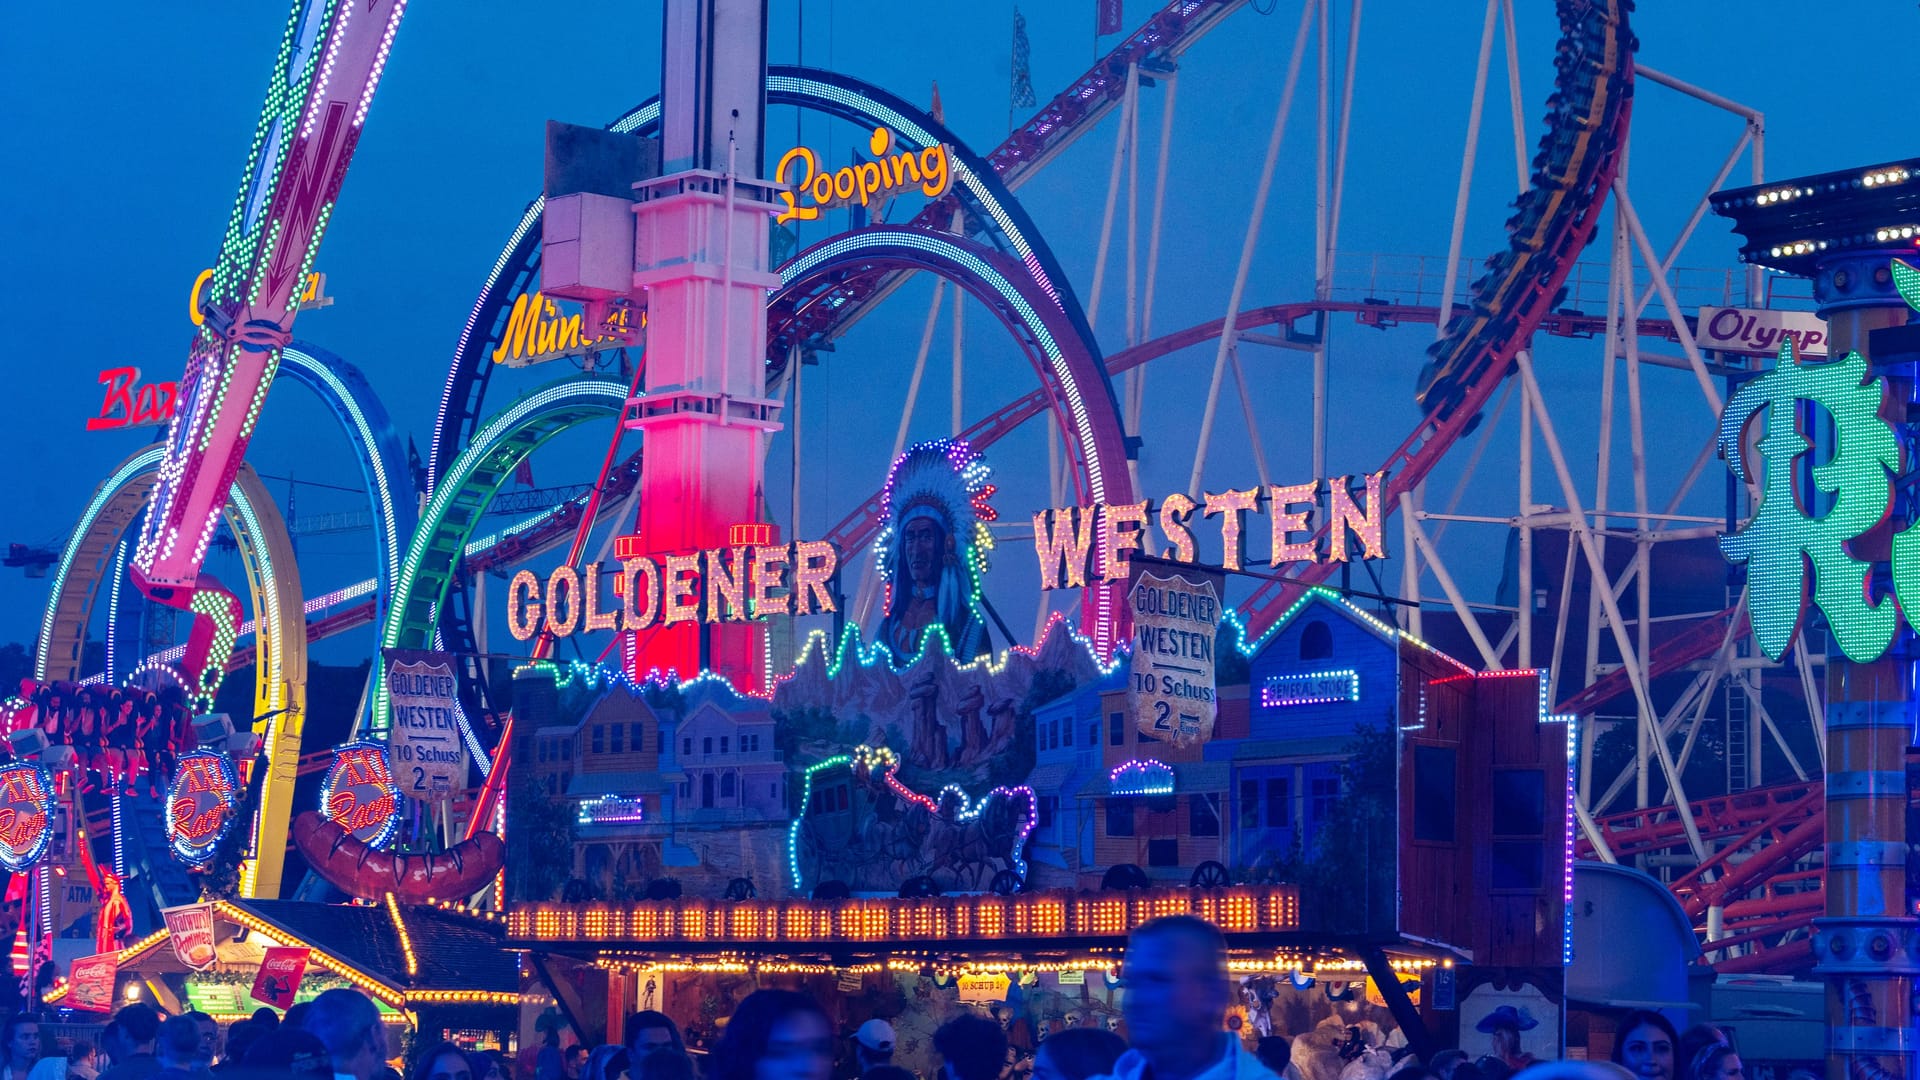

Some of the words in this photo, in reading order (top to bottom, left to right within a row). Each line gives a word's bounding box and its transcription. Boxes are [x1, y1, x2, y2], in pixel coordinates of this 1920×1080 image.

[776, 127, 948, 225] Looping
[1708, 308, 1828, 351] Olymp
[1033, 470, 1388, 591] WESTEN
[508, 540, 838, 641] GOLDENER
[1136, 584, 1217, 627] GOLDENER
[1140, 624, 1211, 663] WESTEN
[391, 671, 457, 699] GOLDENER
[1134, 672, 1156, 694] 10
[1162, 675, 1217, 703] Schuss
[1269, 681, 1316, 699] GENERAL
[1318, 678, 1350, 695] STORE
[395, 704, 455, 732] WESTEN
[395, 744, 412, 762] 10
[417, 745, 461, 764] Schuss
[330, 791, 395, 835] Racer
[67, 885, 93, 903] ATM
[165, 908, 211, 934] Bratwurst
[173, 931, 212, 957] Pommes
